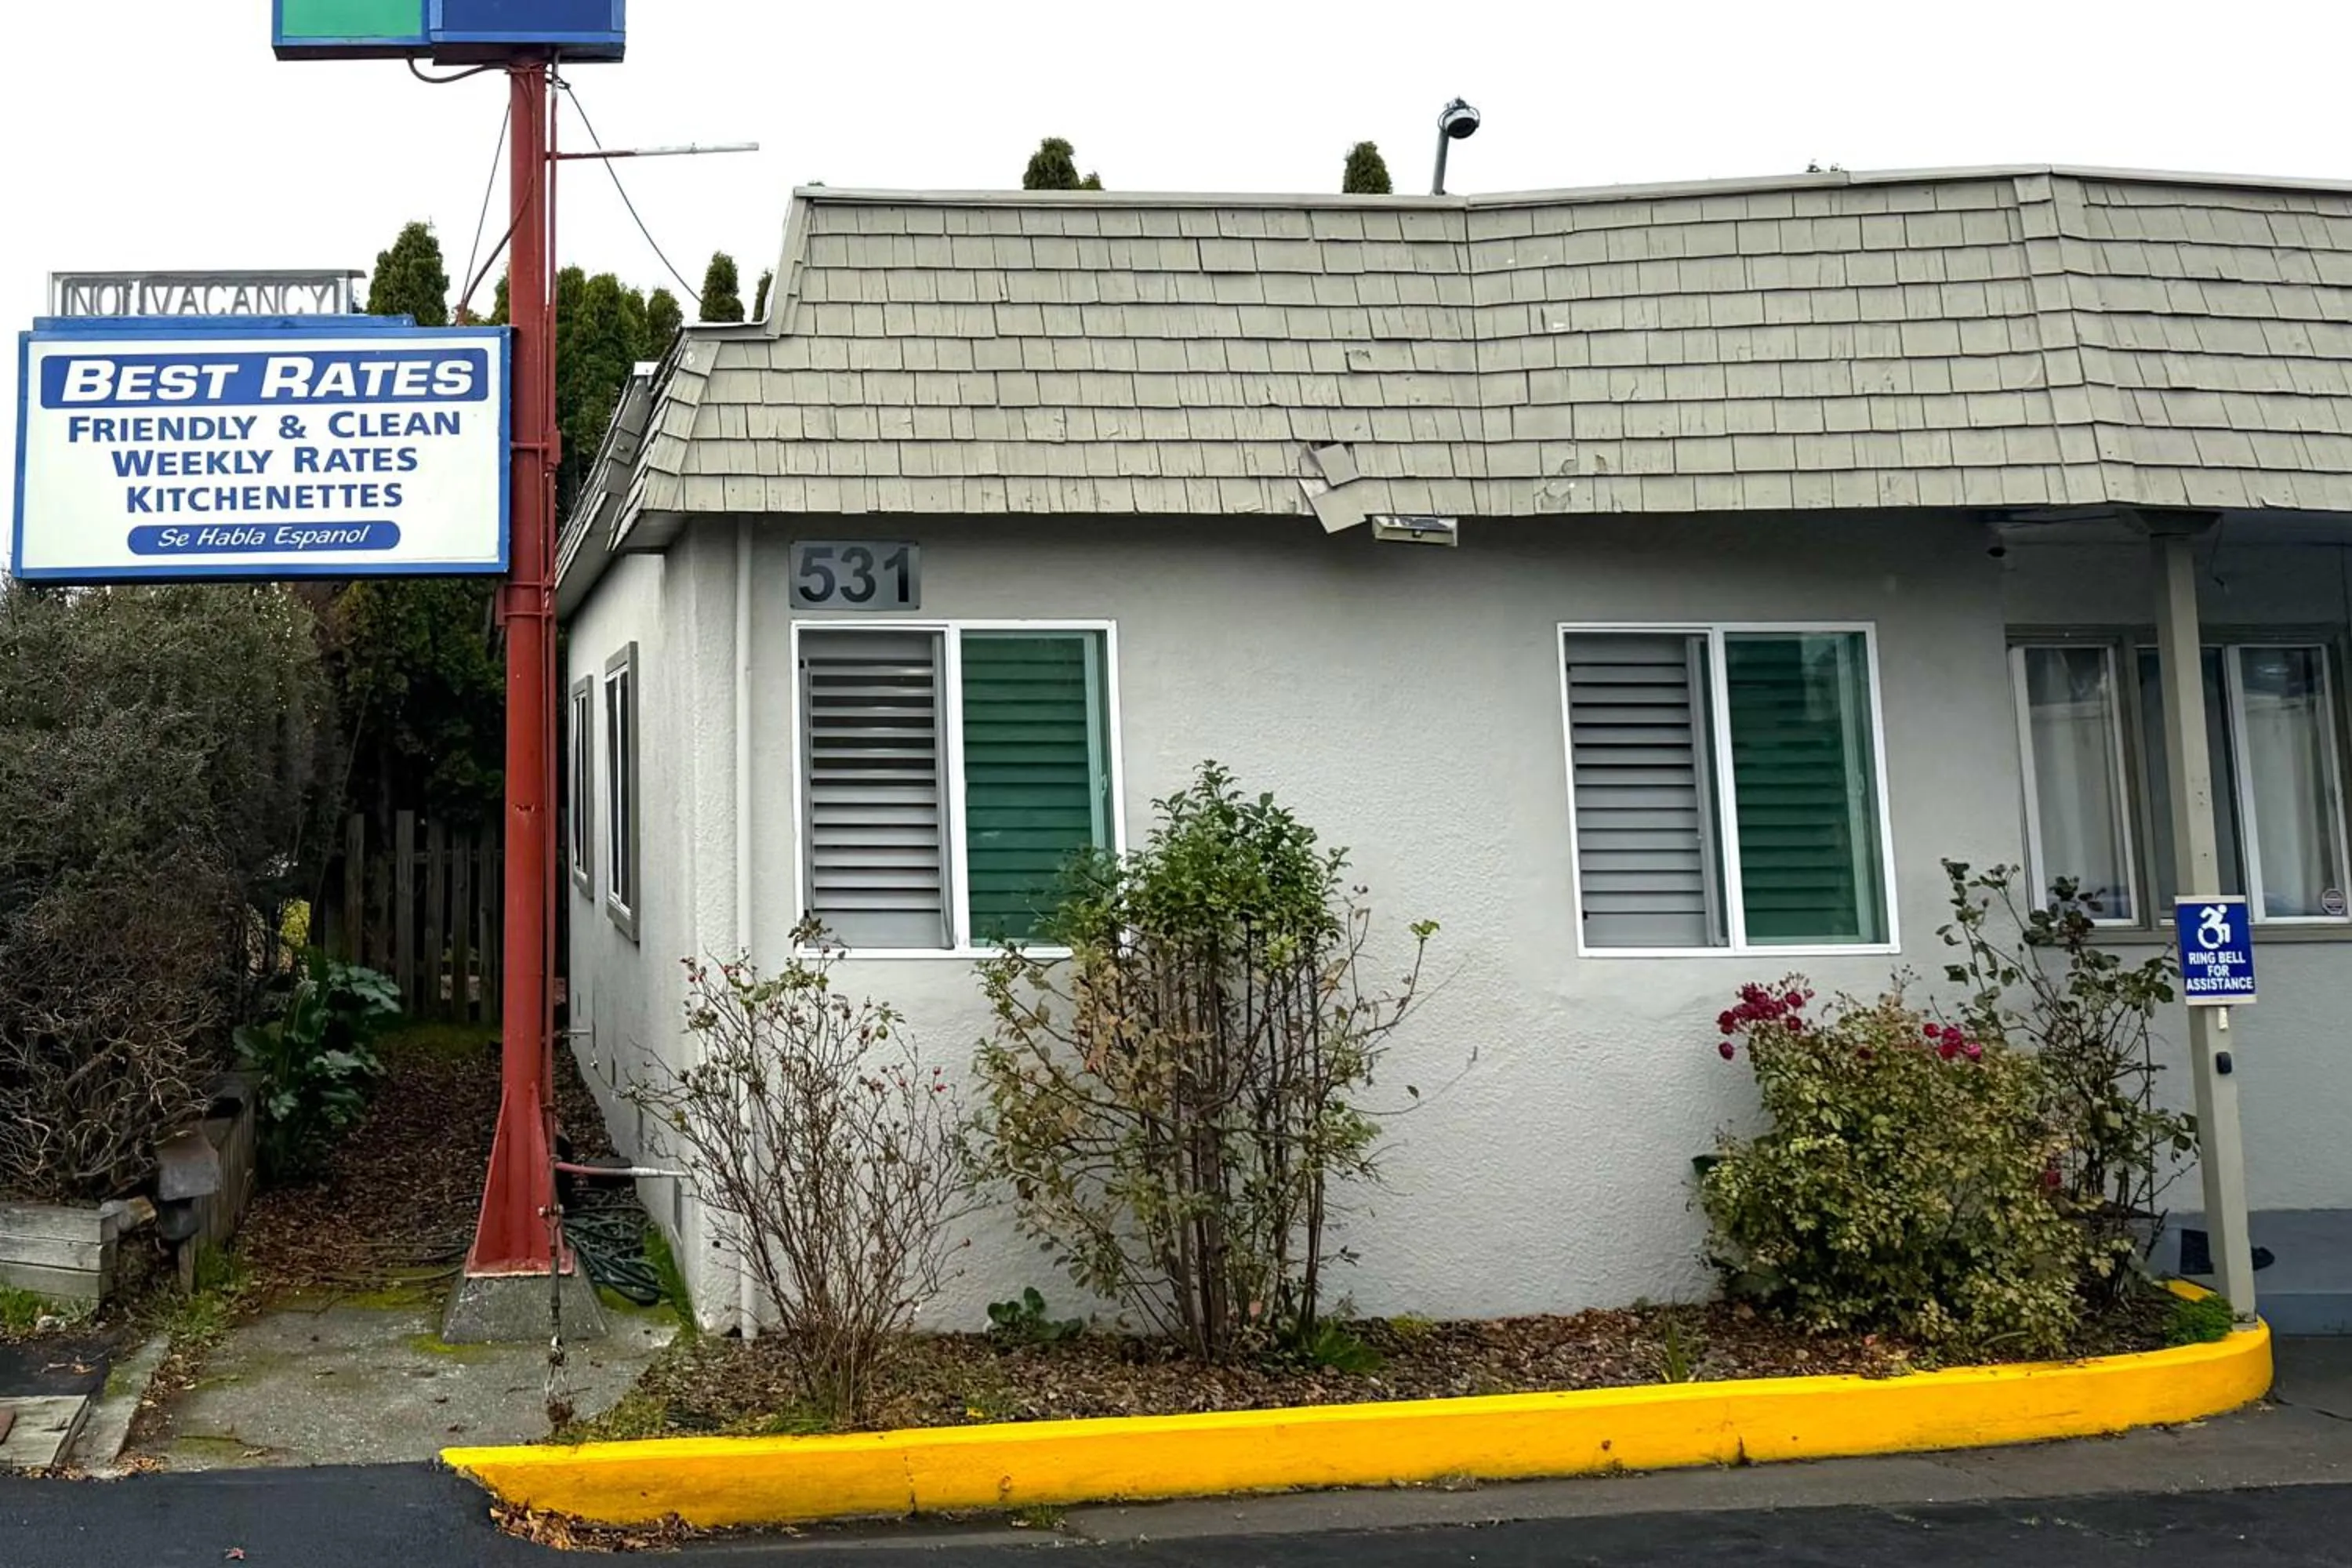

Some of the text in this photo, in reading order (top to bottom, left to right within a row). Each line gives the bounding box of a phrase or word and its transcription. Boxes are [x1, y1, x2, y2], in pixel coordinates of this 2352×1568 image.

[146, 279, 336, 315] VACANCY
[61, 356, 474, 402] BEST RATES
[68, 410, 460, 443] FRIENDLY & CLEAN
[112, 446, 418, 477] WEEKLY RATES
[126, 482, 403, 514] KITCHENETTES
[158, 524, 371, 550] Se Habla Espanol
[798, 546, 909, 603] 531
[2188, 950, 2246, 965] RING BELL
[2207, 964, 2230, 977] FOR
[2186, 976, 2254, 991] ASSISTANCE
